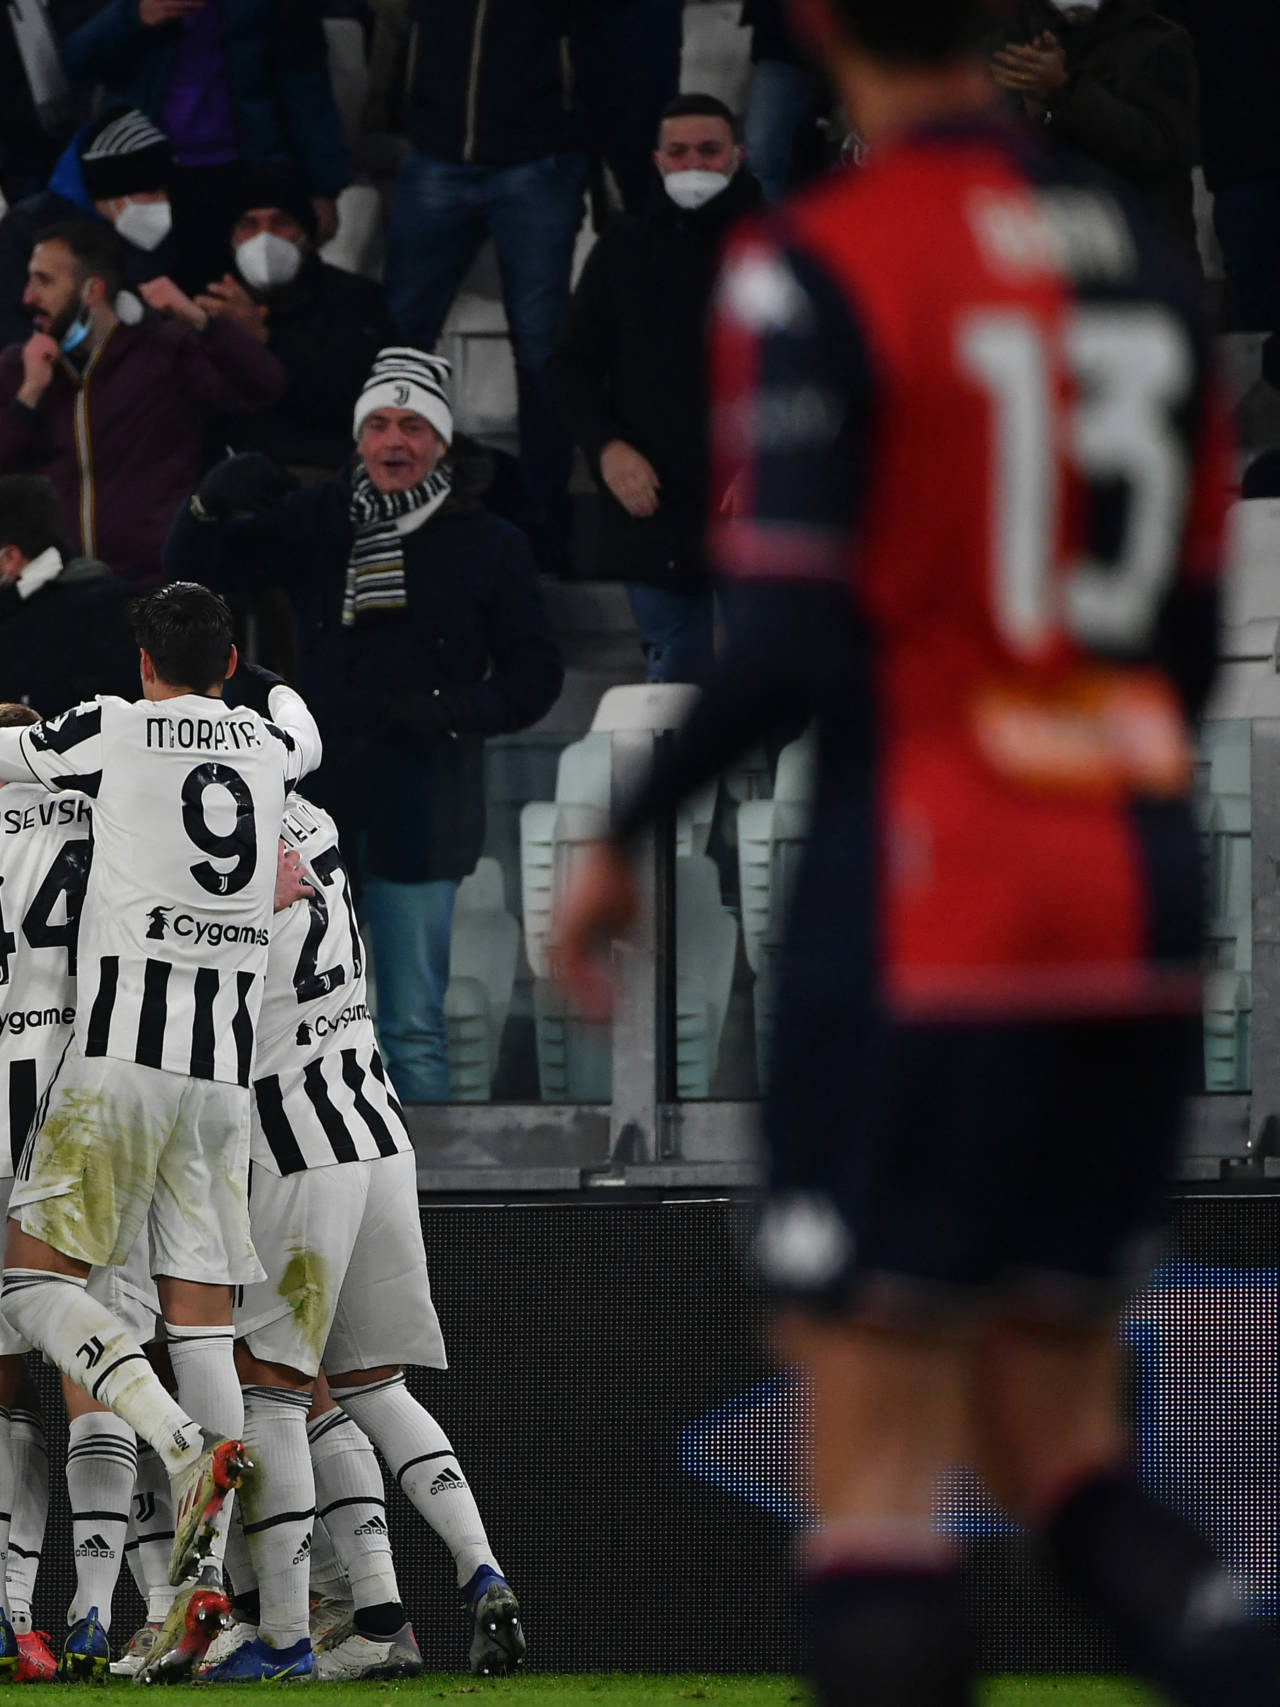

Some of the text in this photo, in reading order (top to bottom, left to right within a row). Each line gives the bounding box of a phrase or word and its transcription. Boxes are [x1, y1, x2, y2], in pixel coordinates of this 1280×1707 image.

[956, 308, 1194, 660] 13
[146, 718, 261, 750] MORATA
[181, 762, 257, 896] 9
[75, 1548, 115, 1559] adidas
